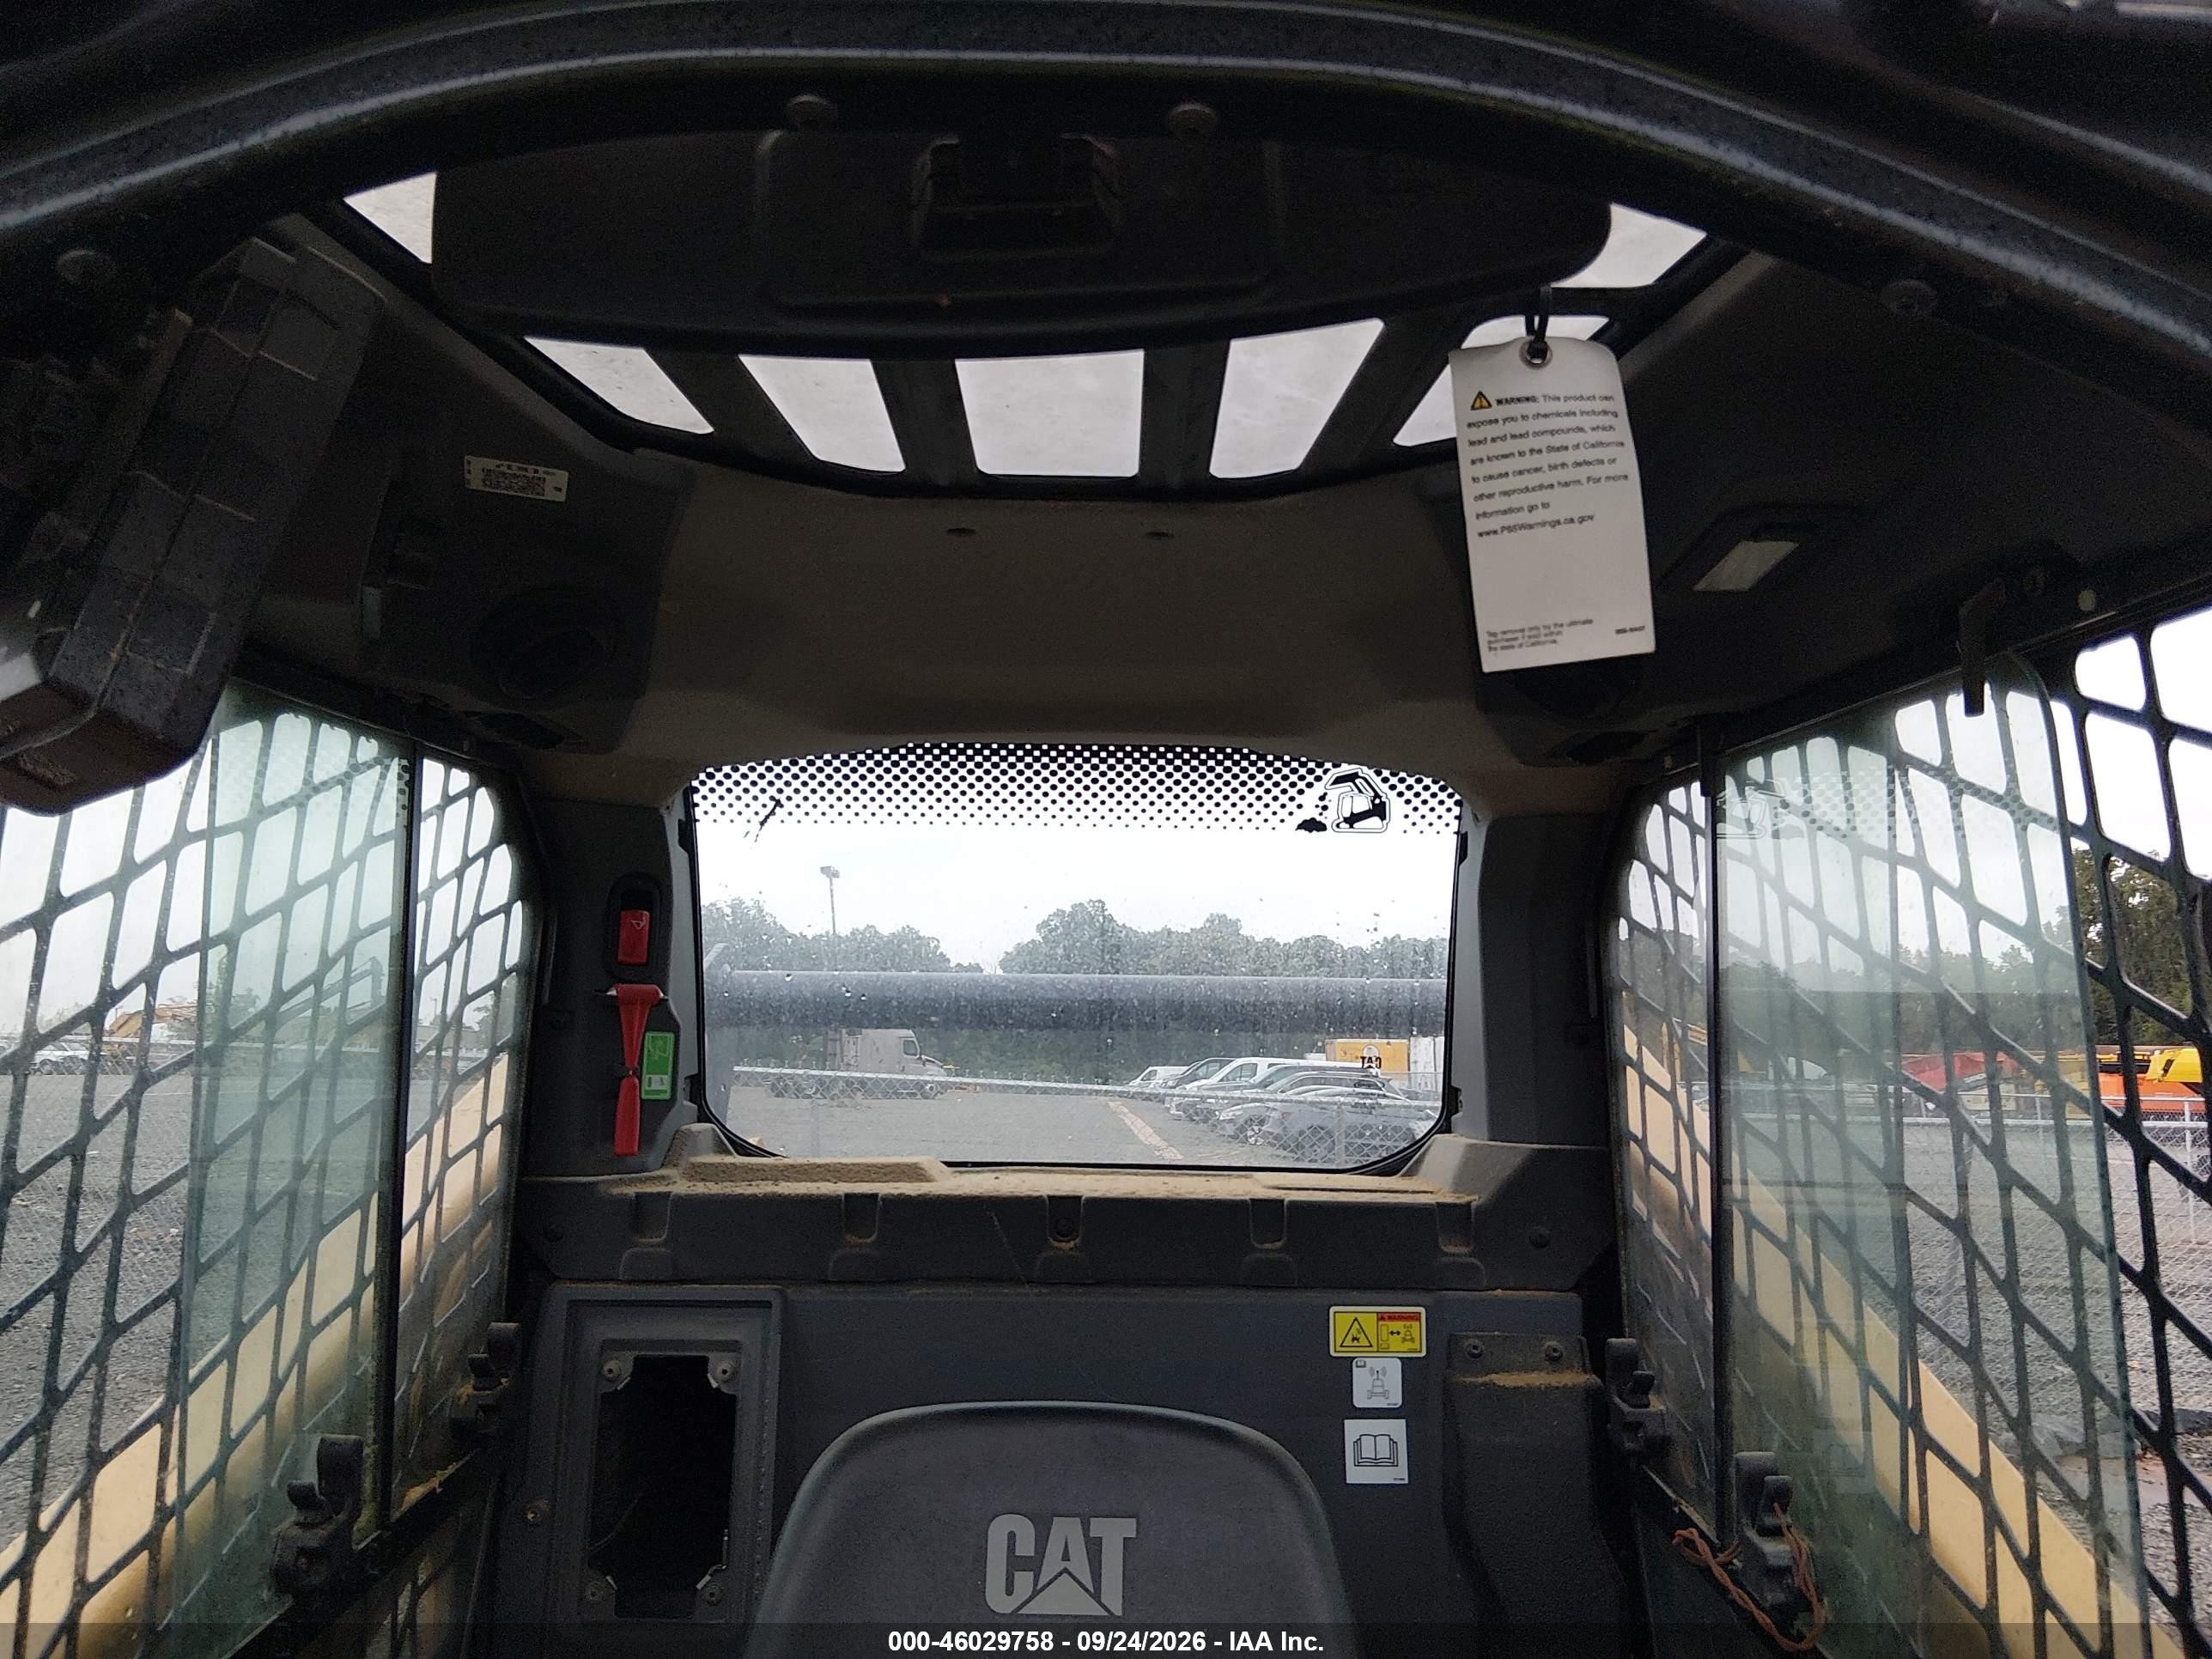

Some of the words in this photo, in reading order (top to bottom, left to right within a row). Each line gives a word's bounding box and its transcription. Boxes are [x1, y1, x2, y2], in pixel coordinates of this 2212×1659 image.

[1495, 395, 1540, 406] WARNING:
[1541, 394, 1561, 403] This
[1563, 394, 1596, 403] product
[1467, 418, 1499, 429] expose
[1501, 416, 1518, 426] you
[1532, 410, 1577, 421] chemicals
[1579, 409, 1618, 418] including
[1468, 436, 1488, 447] lead
[1490, 434, 1508, 443] and
[1509, 430, 1530, 440] lead
[1532, 425, 1588, 438] compounds,
[1469, 458, 1485, 466] are
[1486, 452, 1516, 462] known
[1517, 449, 1527, 458] to
[1528, 447, 1543, 456] the
[1545, 445, 1569, 454] State
[1571, 442, 1581, 451] of
[1583, 441, 1626, 450] California
[1471, 476, 1480, 484] to
[1482, 471, 1510, 483] cause
[1511, 466, 1546, 477] cancer,
[1547, 462, 1569, 472] birth
[1571, 459, 1605, 469] defects
[1474, 491, 1496, 502] other
[1498, 483, 1555, 498] reproductive
[1557, 479, 1584, 489] harm.
[1586, 476, 1602, 485] For
[1604, 473, 1630, 483] more
[1475, 505, 1525, 520] information
[1527, 503, 1540, 514] go
[1540, 501, 1551, 509] to
[985, 1513, 1137, 1616] CAT
